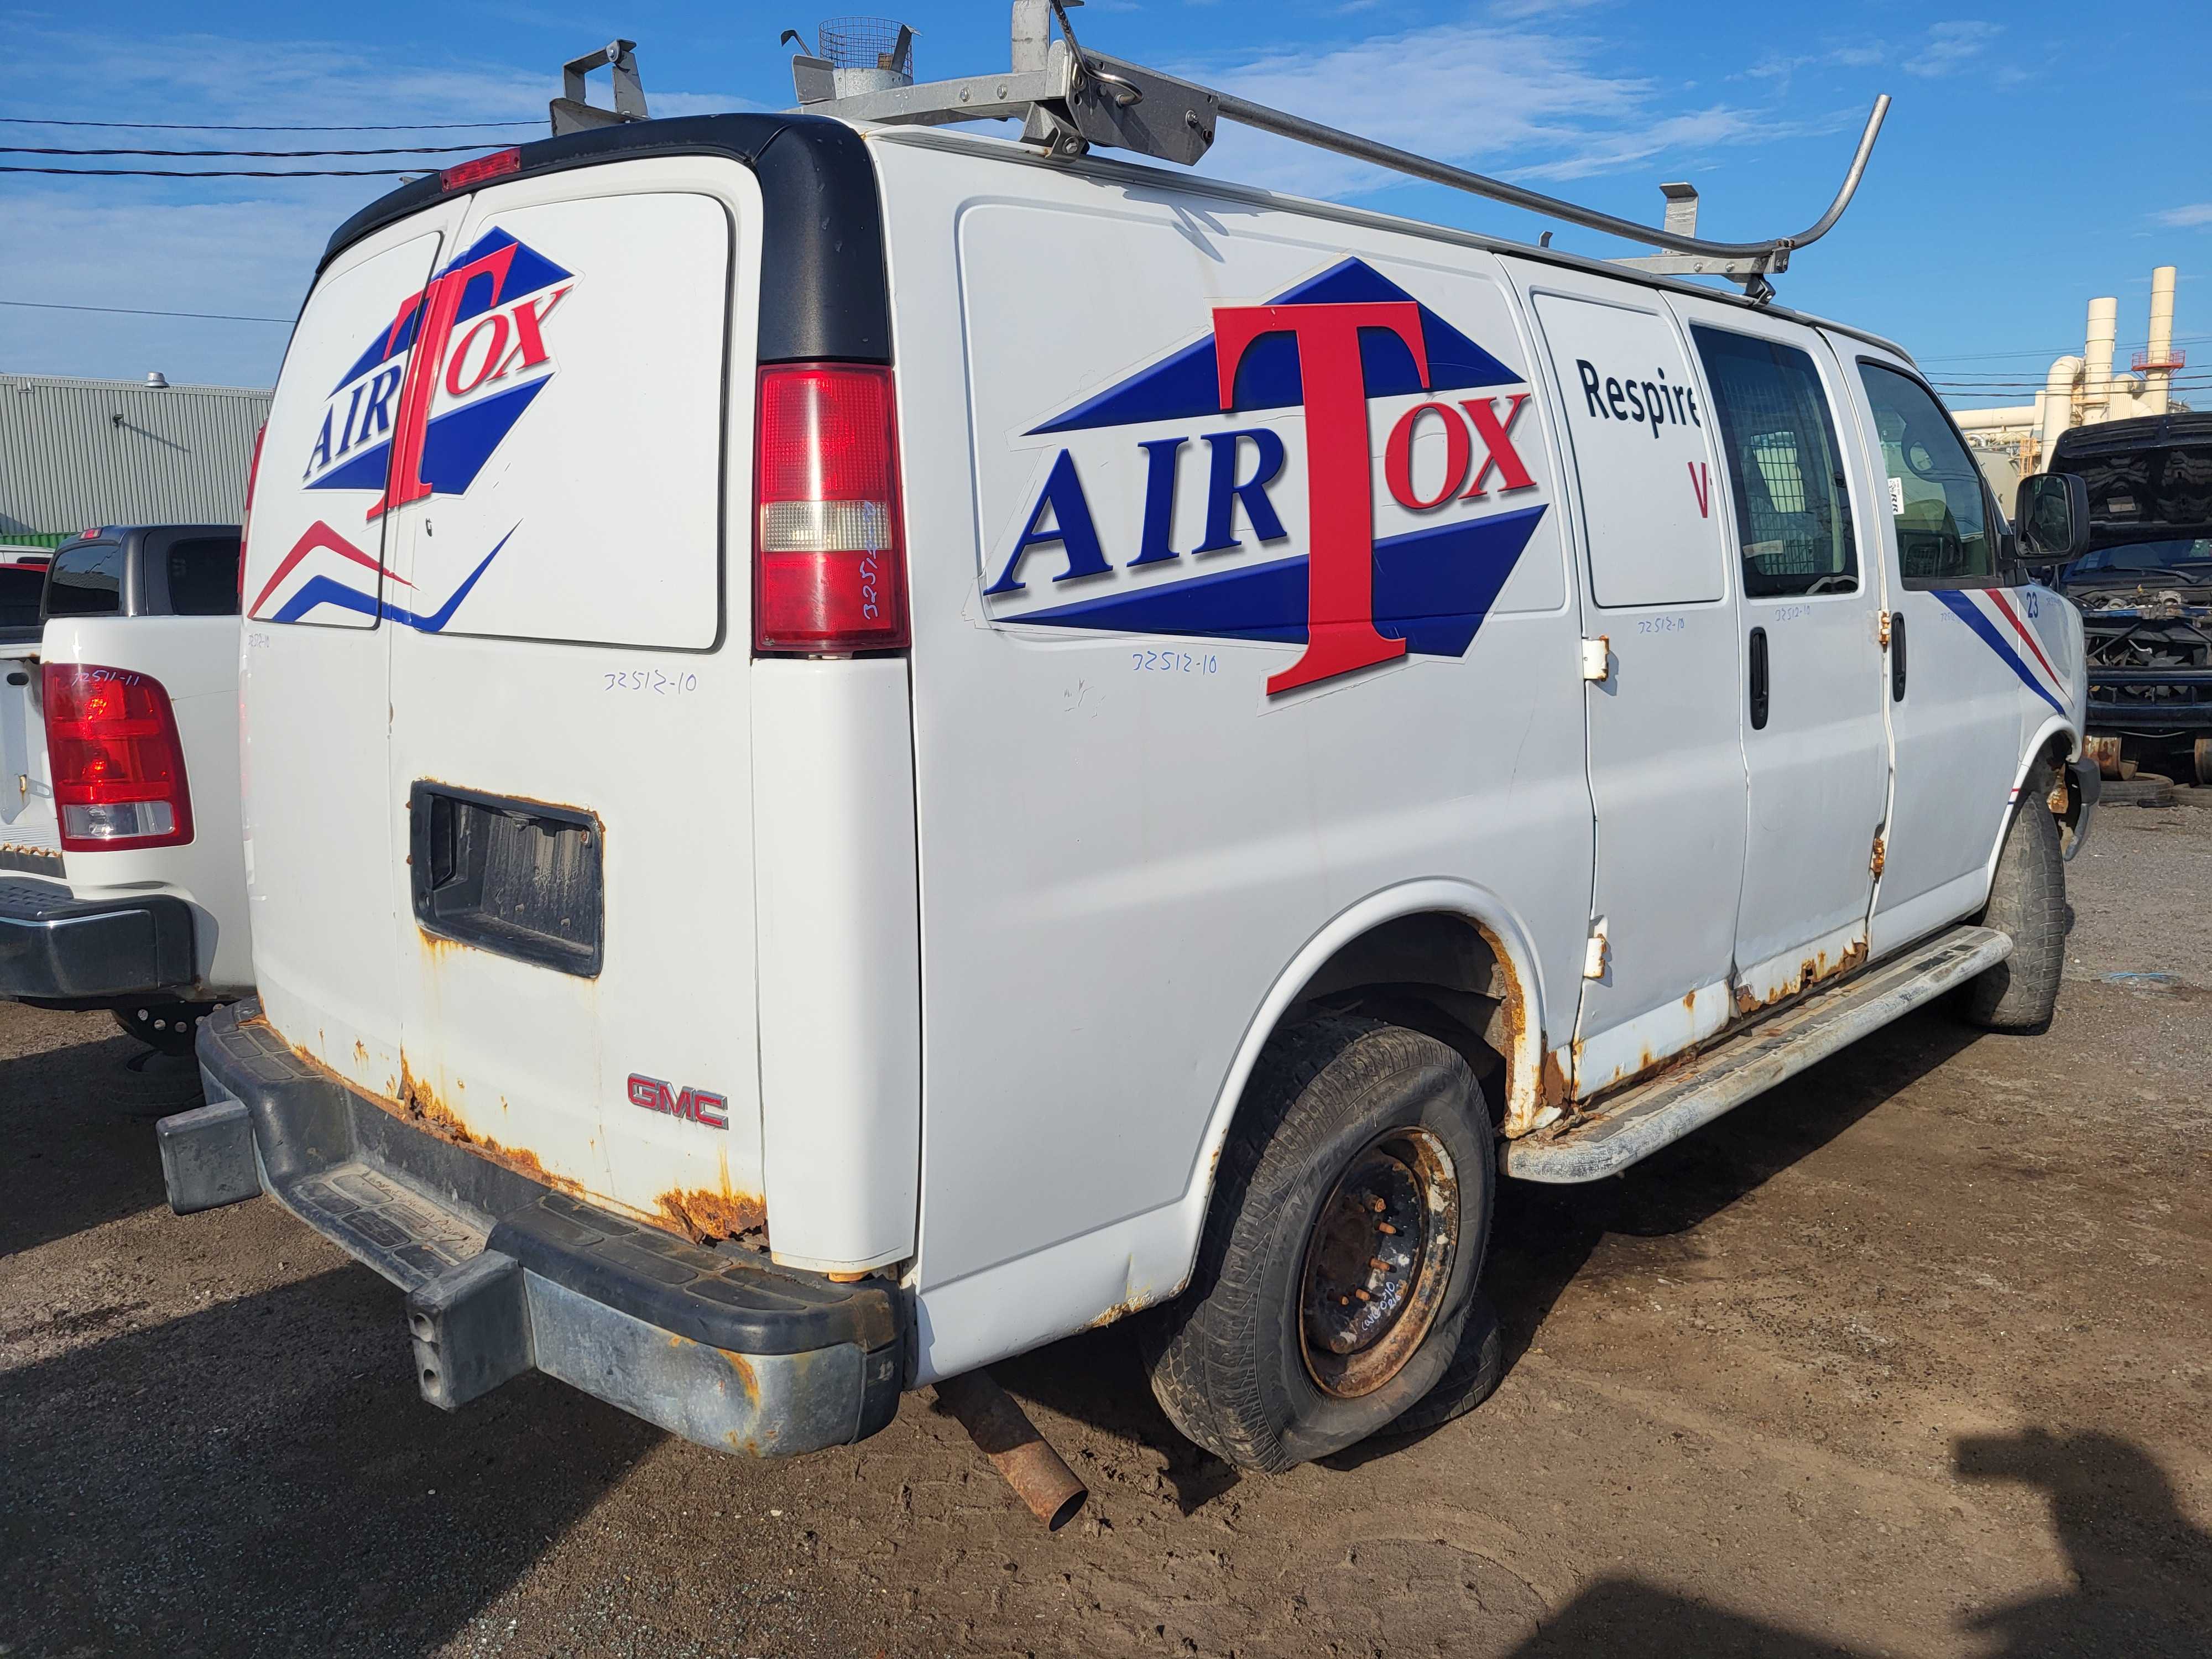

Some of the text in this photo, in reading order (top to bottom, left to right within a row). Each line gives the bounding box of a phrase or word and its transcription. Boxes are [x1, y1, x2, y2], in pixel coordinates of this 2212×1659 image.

[2026, 591, 2039, 618] 23
[604, 669, 697, 695] 32512-10
[627, 1072, 729, 1131] GMC
